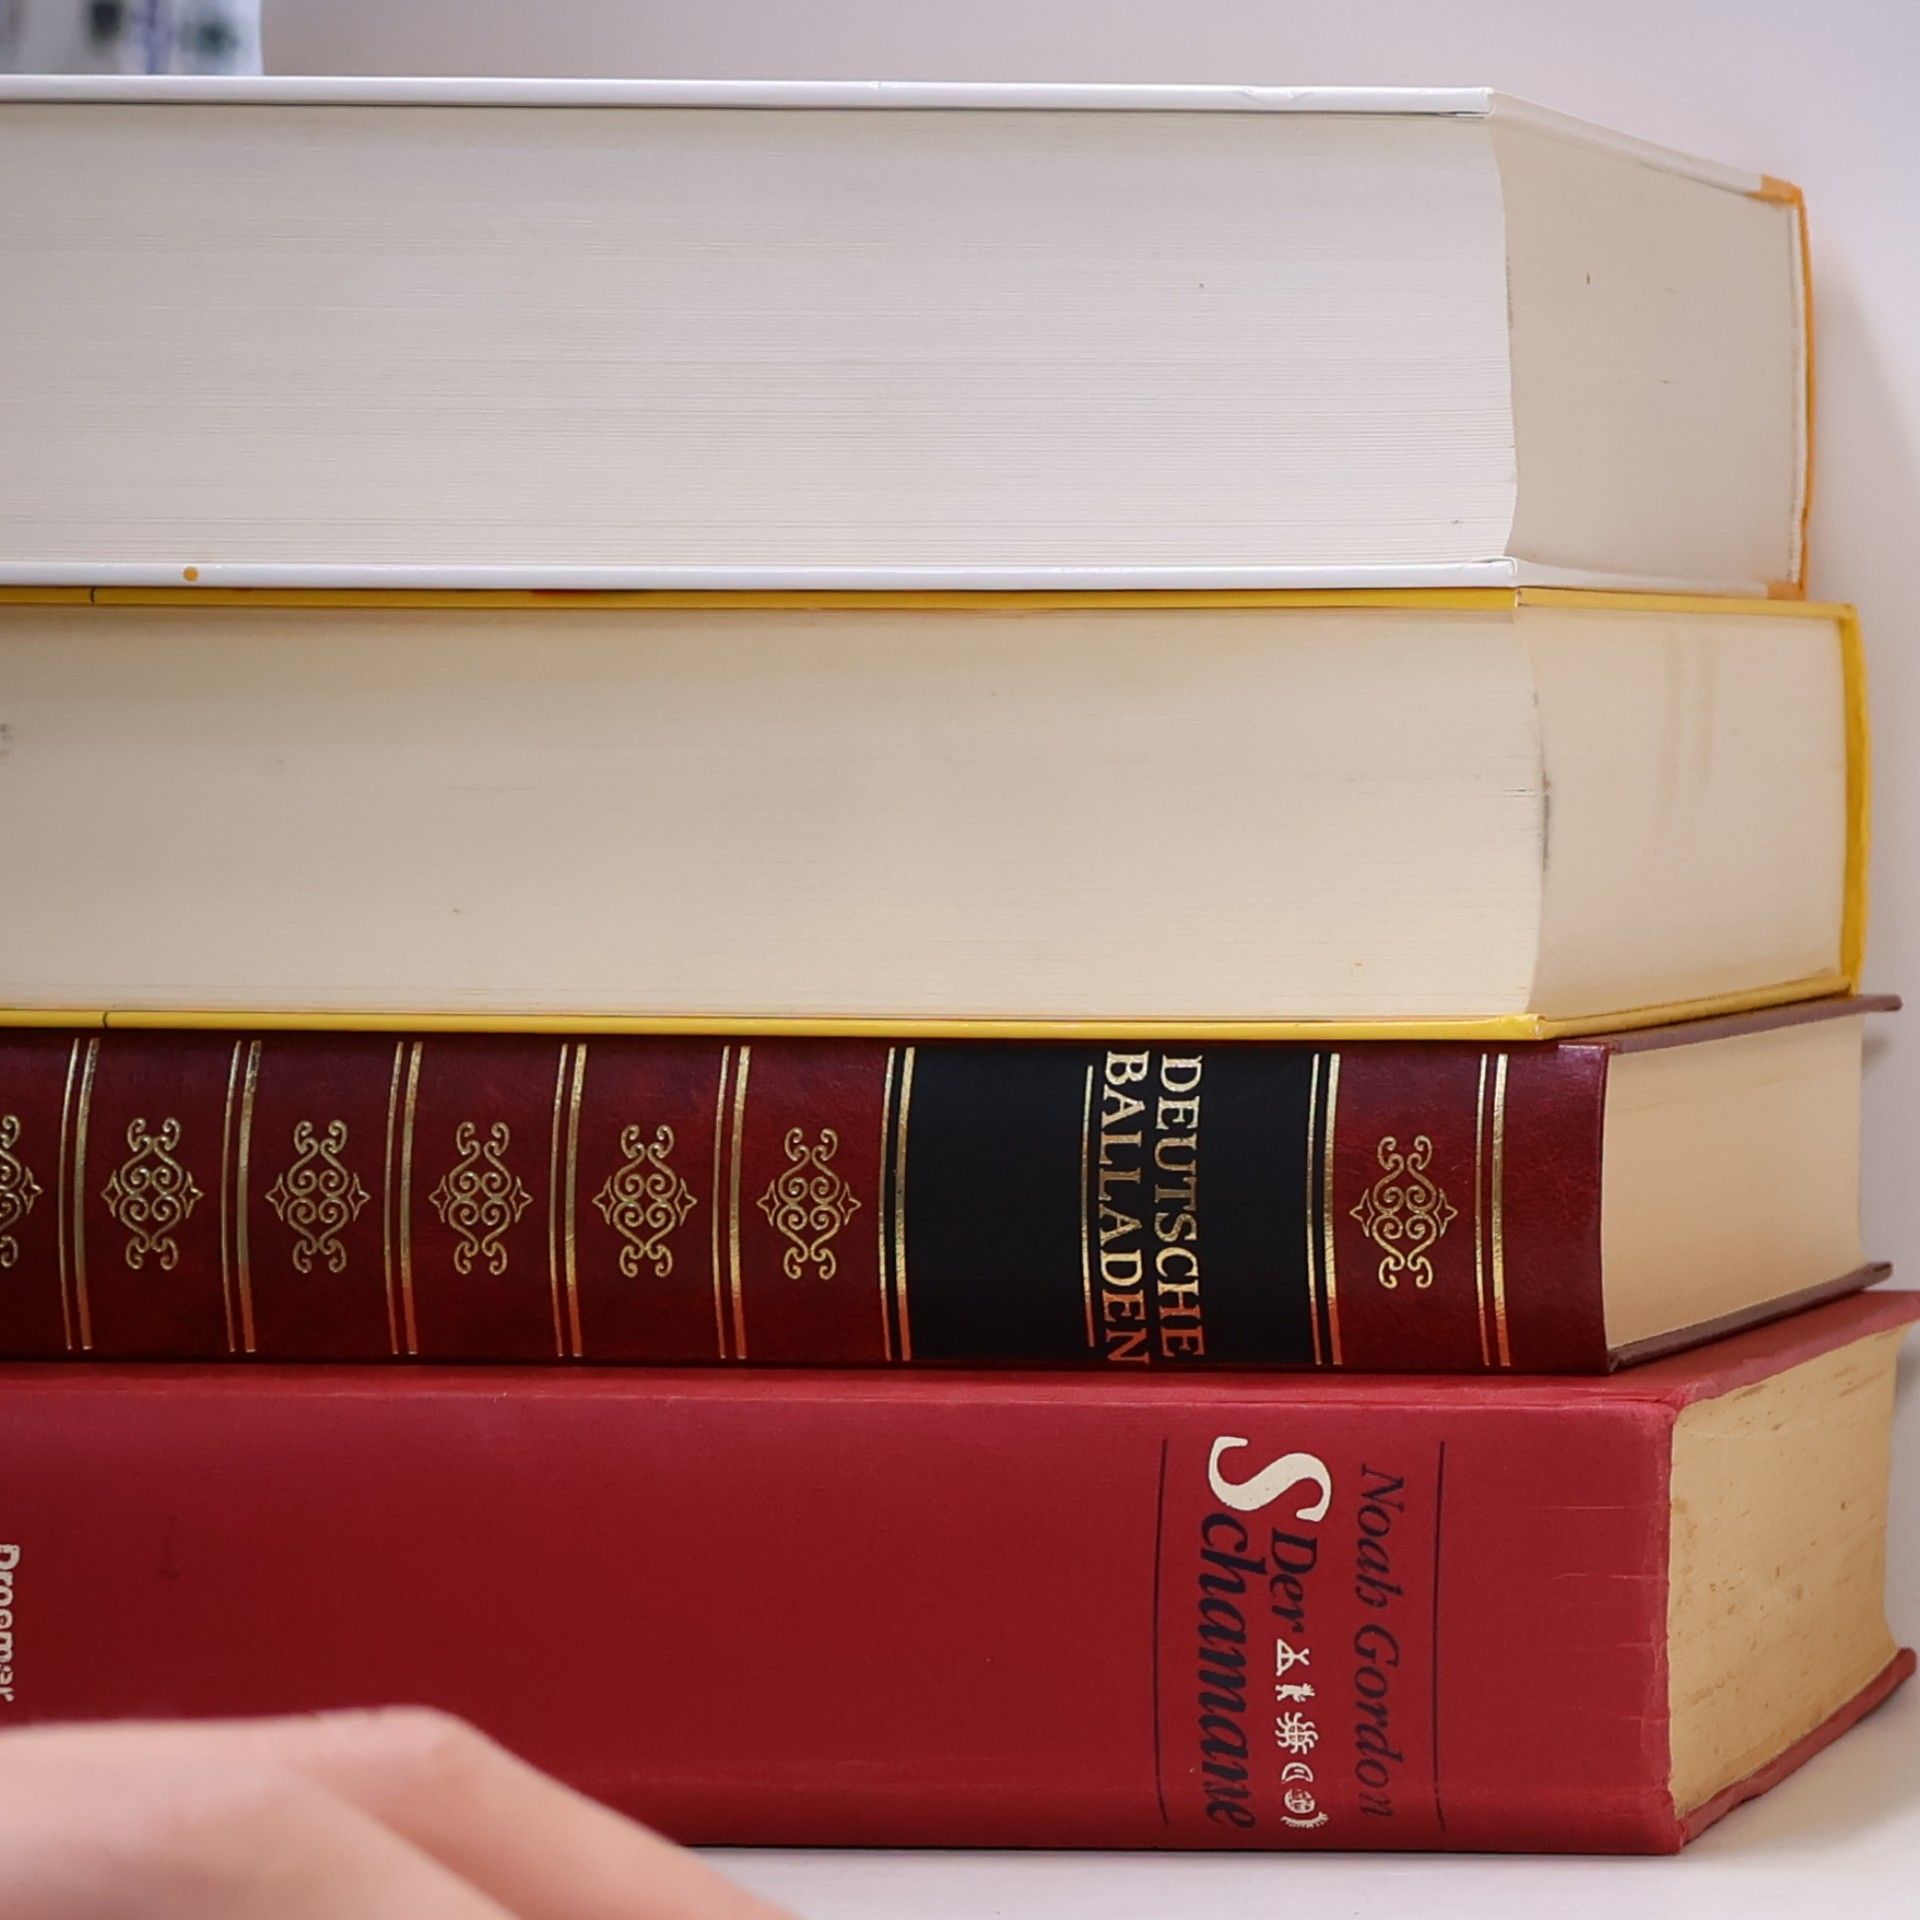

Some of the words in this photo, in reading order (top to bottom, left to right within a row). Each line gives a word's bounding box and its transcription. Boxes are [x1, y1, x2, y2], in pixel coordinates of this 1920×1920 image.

[1098, 1050, 1150, 1365] BALLADEN
[1154, 1055, 1205, 1357] DEUTSCHE
[1198, 1436, 1332, 1829] Schamane
[1271, 1527, 1318, 1632] Der
[1353, 1464, 1404, 1609] Noah
[1354, 1624, 1404, 1817] Gordon
